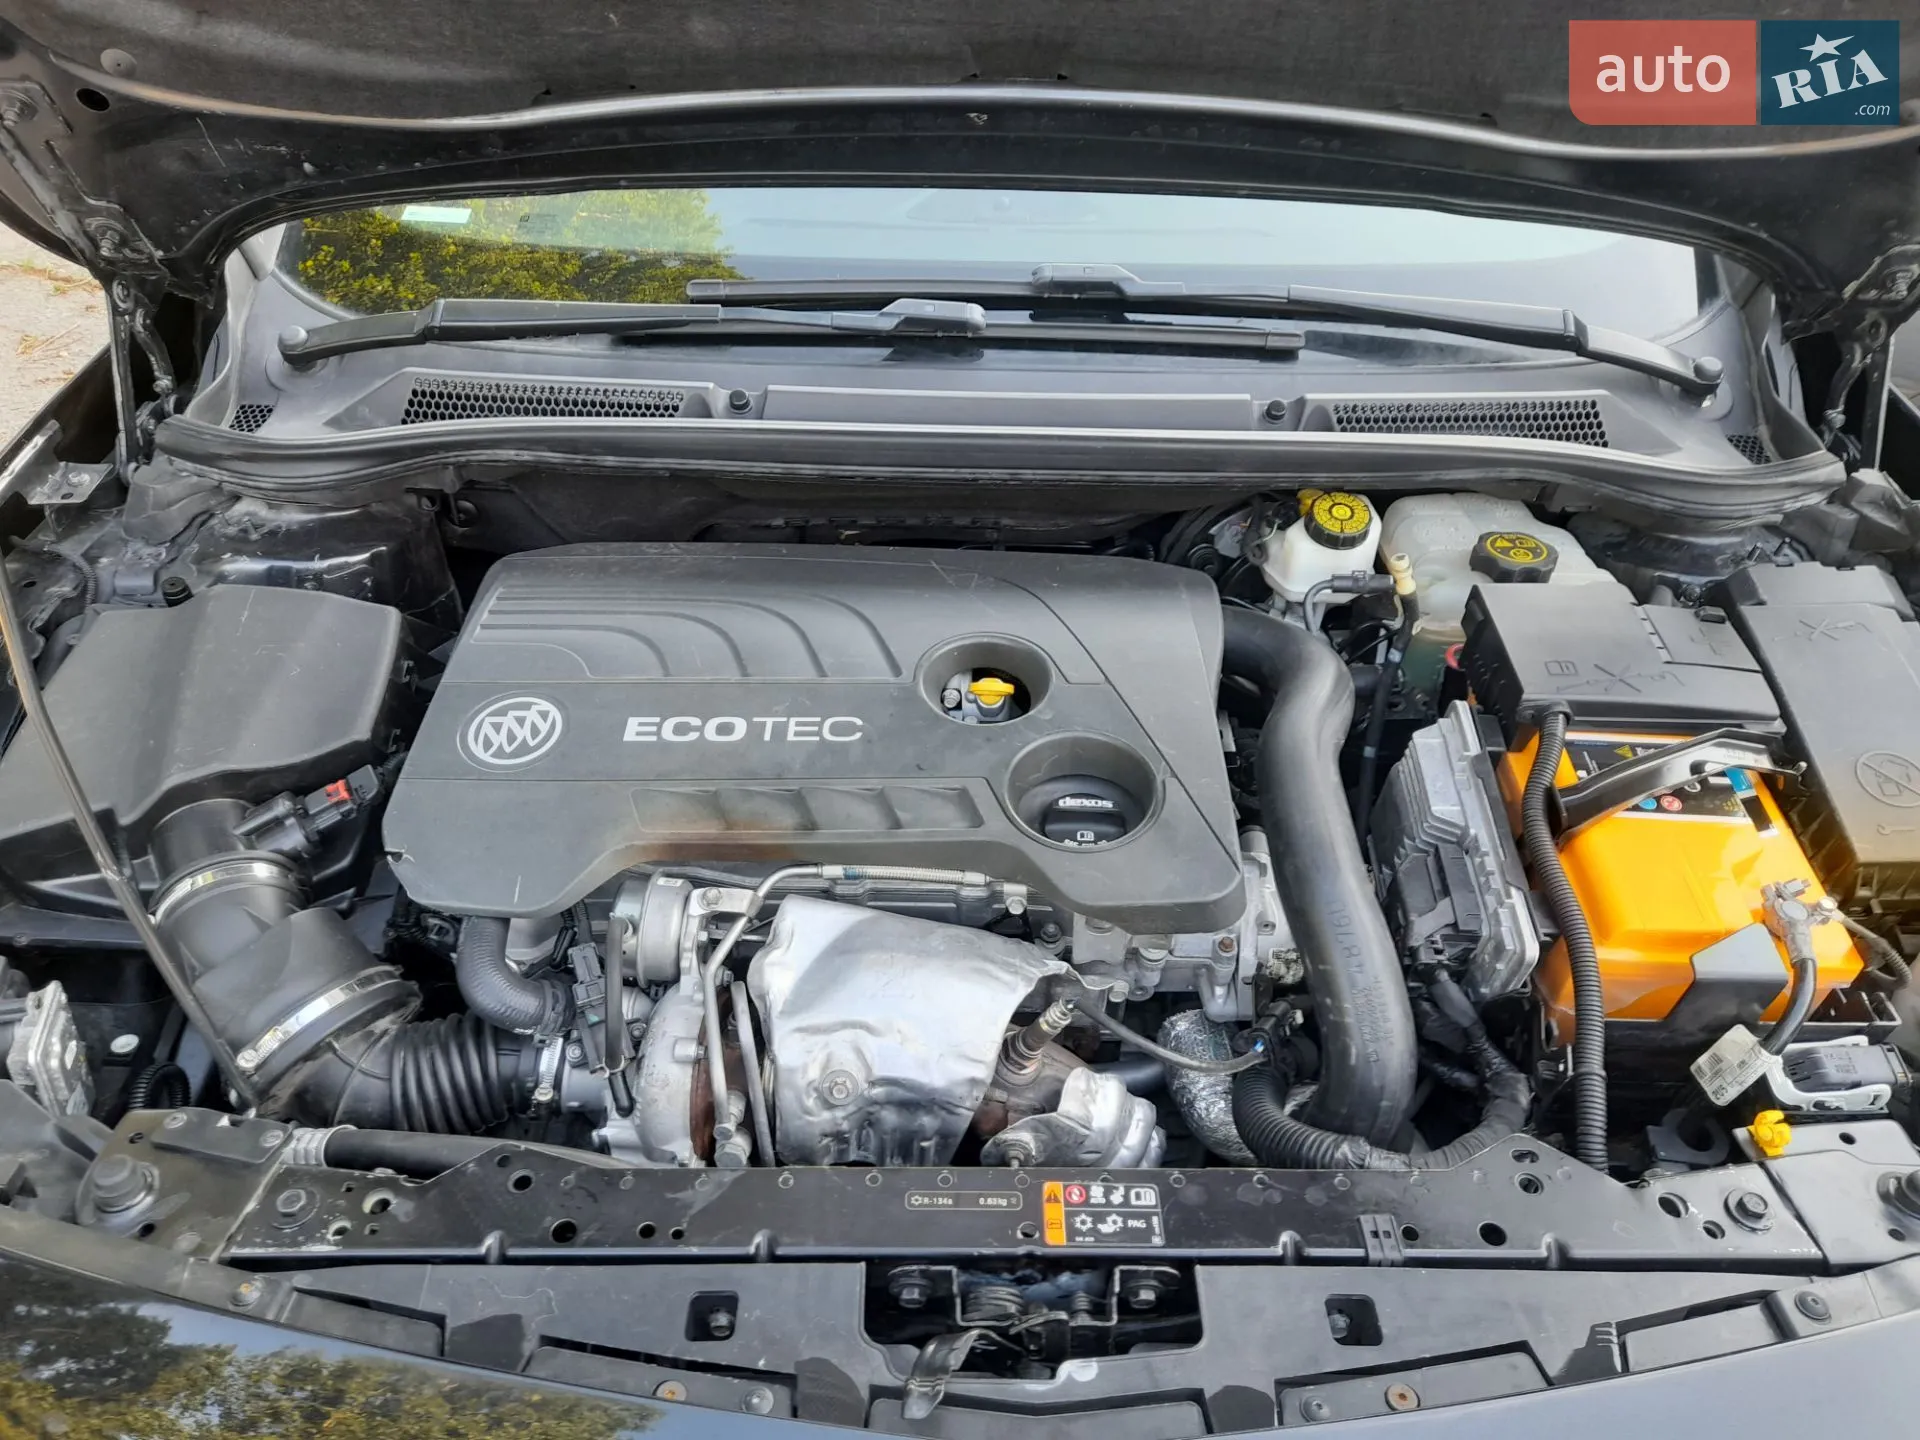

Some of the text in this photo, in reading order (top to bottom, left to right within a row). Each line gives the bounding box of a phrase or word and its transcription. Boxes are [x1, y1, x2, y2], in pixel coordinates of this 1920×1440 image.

[623, 716, 864, 742] ECOTEC
[1058, 797, 1114, 808] dexos
[923, 1197, 953, 1205] R-134a
[1127, 1219, 1147, 1228] PAG
